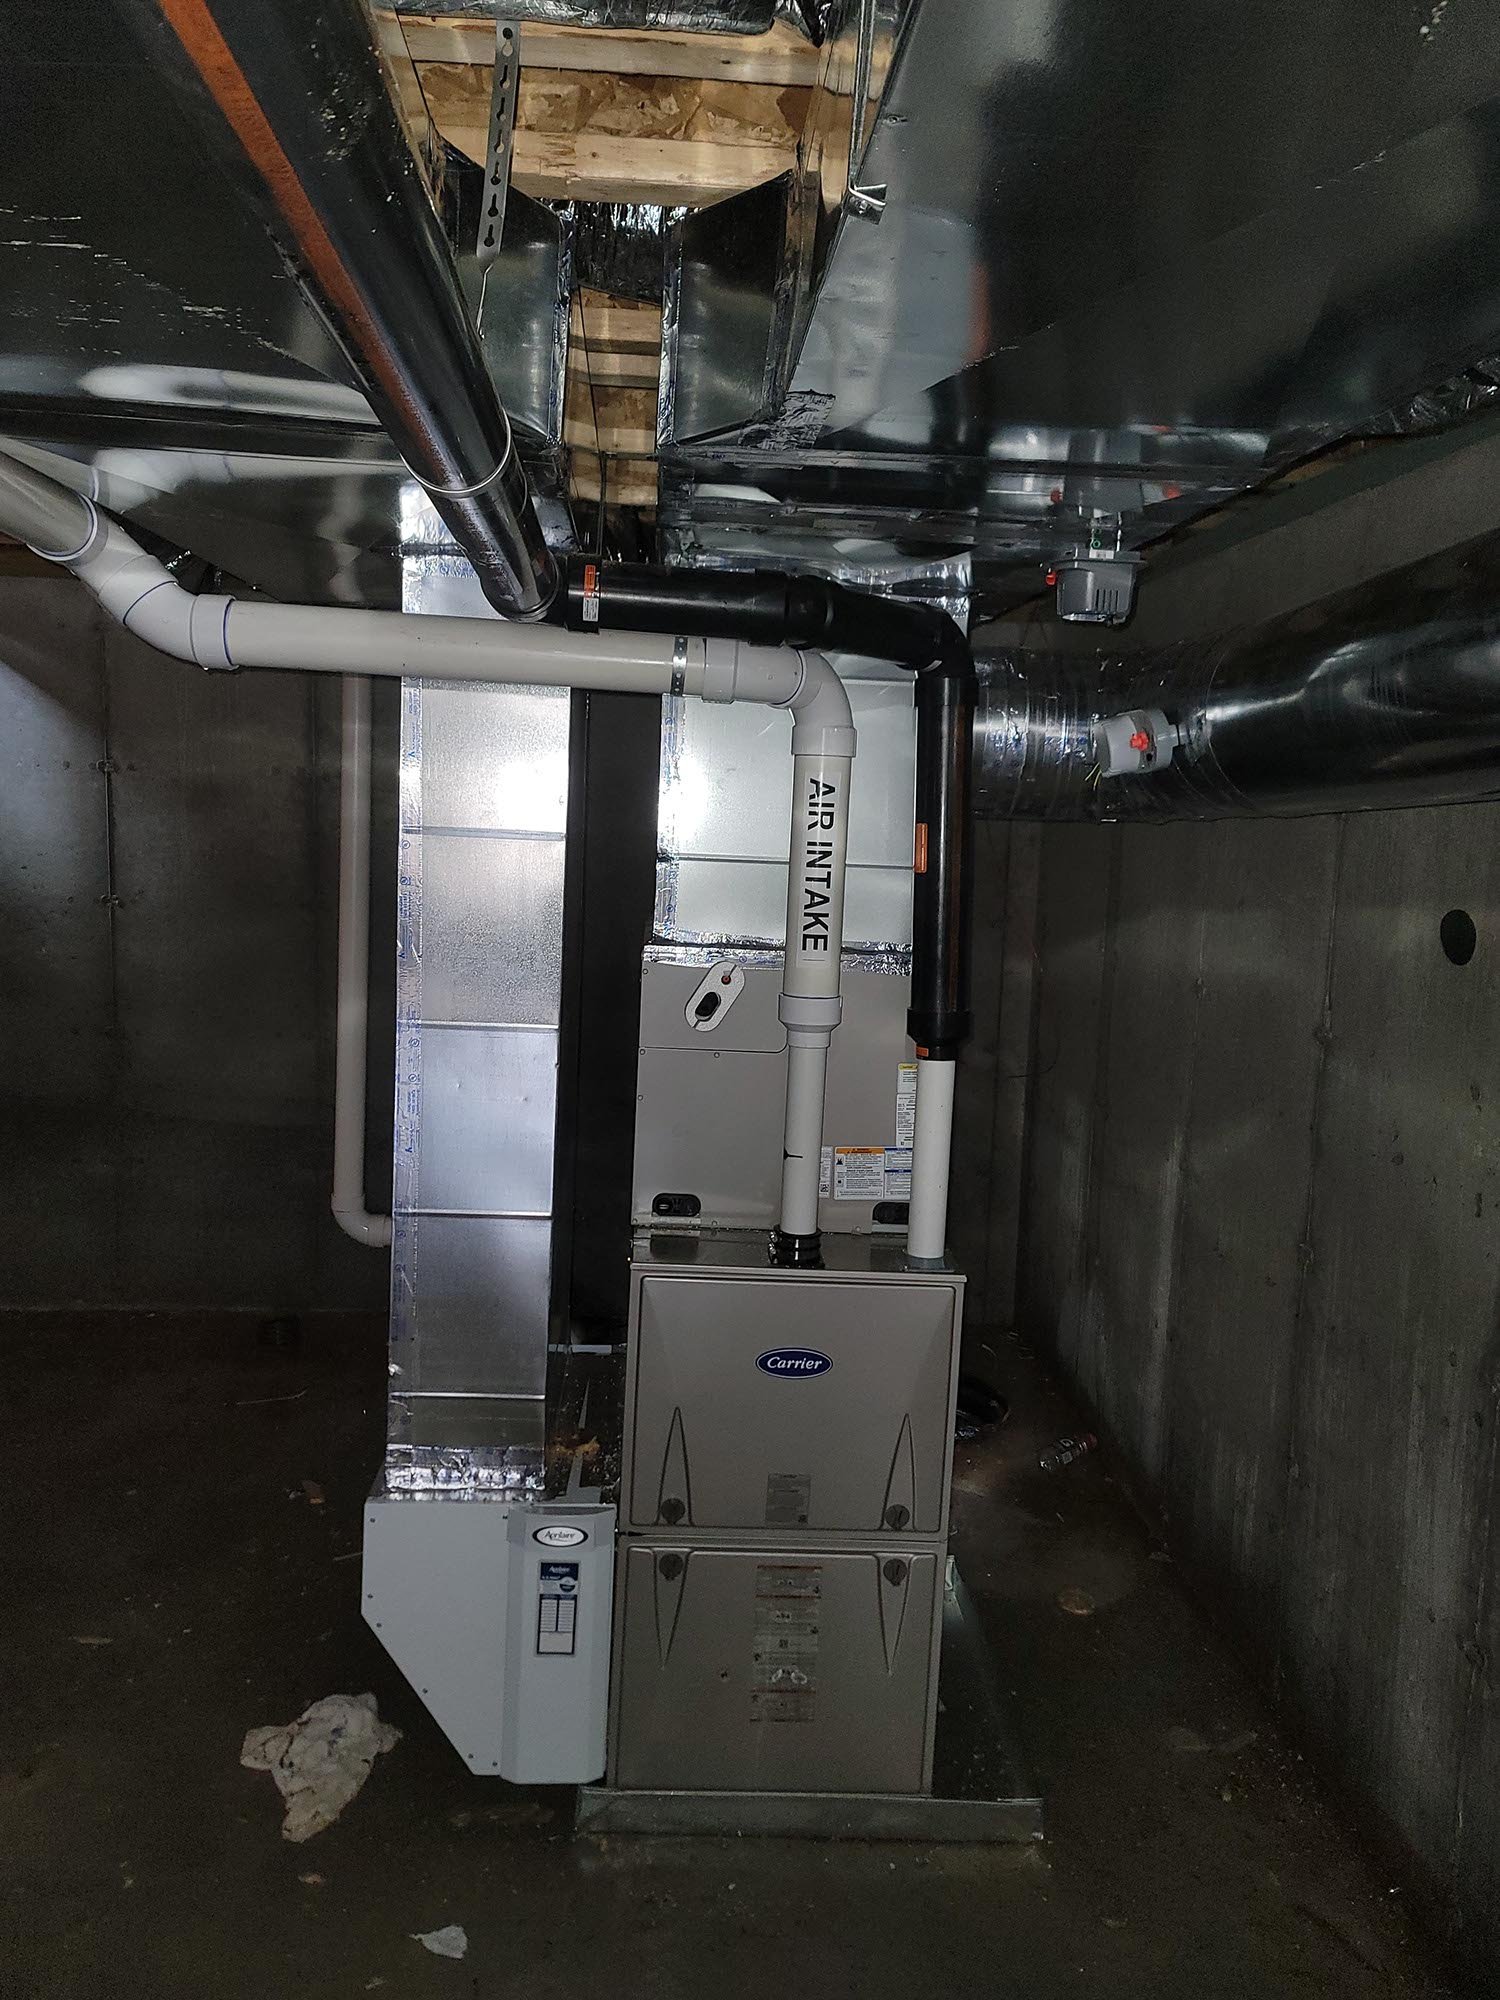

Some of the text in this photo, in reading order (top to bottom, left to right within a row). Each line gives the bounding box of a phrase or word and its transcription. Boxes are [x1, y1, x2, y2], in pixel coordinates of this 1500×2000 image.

[802, 778, 835, 951] AIR INTAKE
[767, 1356, 822, 1370] Carrier
